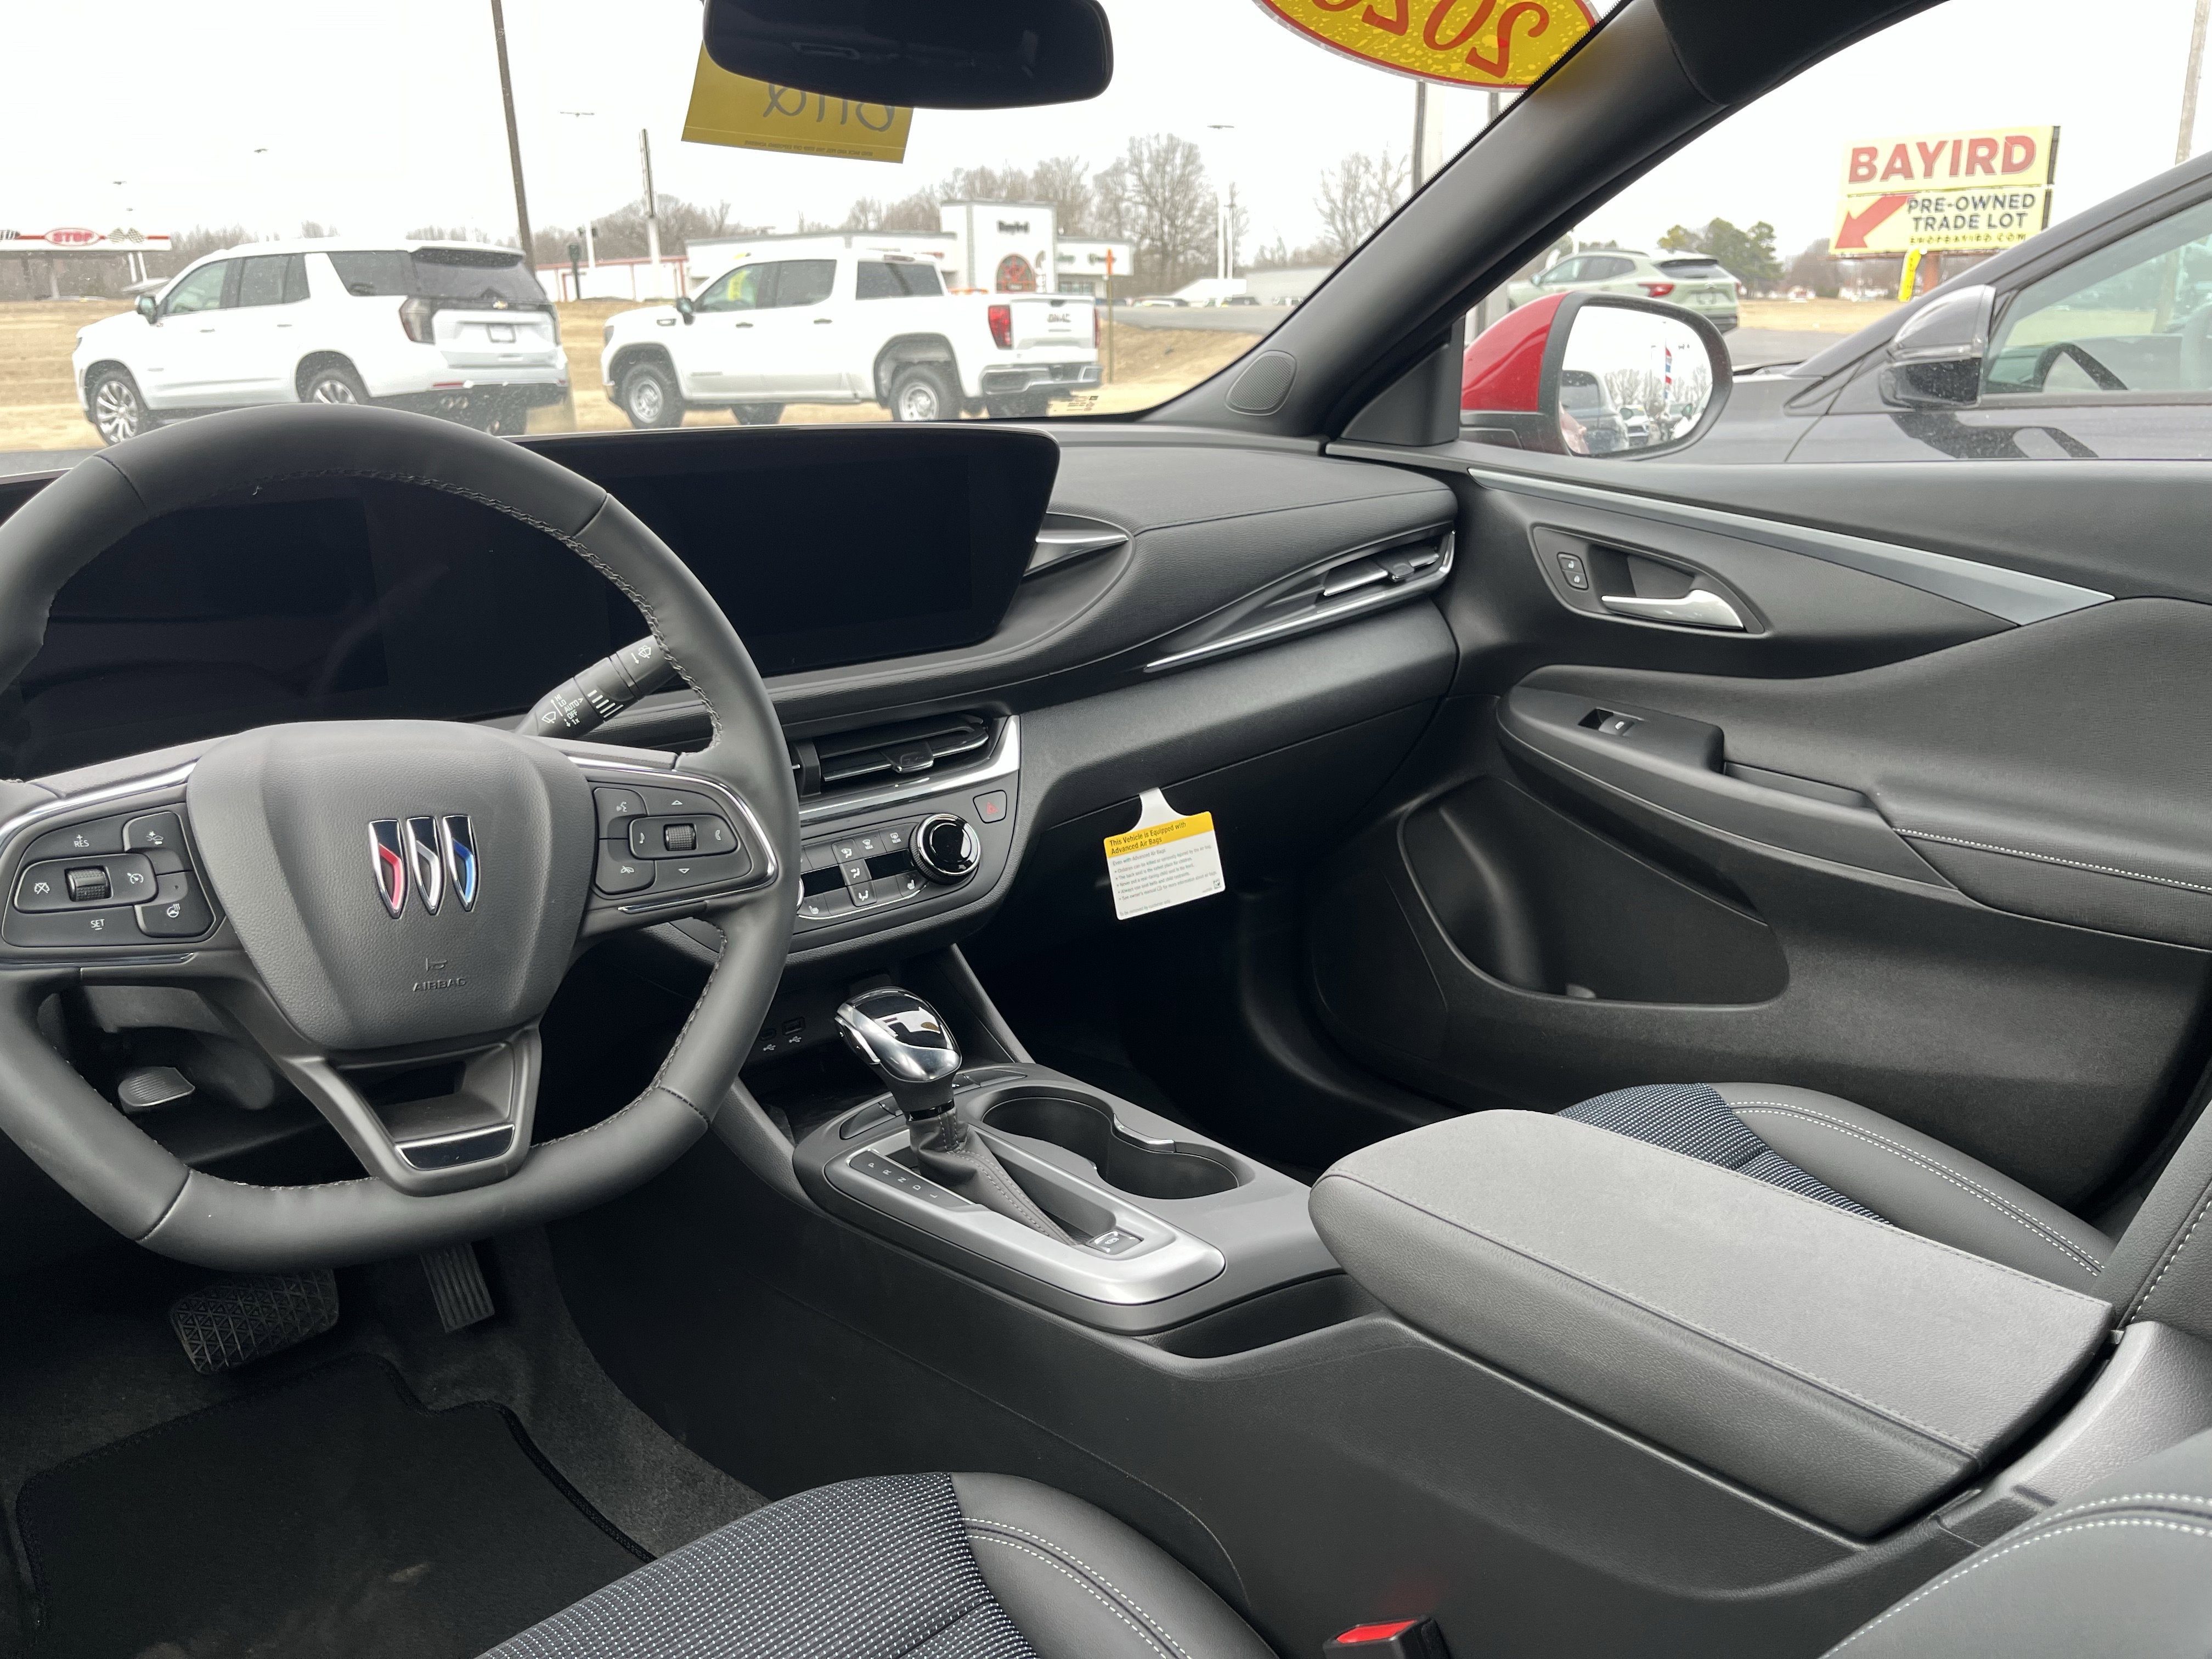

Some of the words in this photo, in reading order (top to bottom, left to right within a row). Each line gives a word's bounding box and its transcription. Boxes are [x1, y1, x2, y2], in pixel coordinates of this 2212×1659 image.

[1848, 135, 2036, 184] BAYIRD
[1908, 193, 2036, 214] PRE-OWNED
[1912, 213, 1980, 232] TRADE
[1988, 211, 2028, 229] LOT
[558, 699, 567, 707] LO
[567, 709, 578, 720] OFF
[1123, 833, 1143, 843] Vehicle
[1150, 825, 1174, 836] Equipped
[1111, 843, 1138, 855] Advanced
[90, 918, 105, 928] SET
[413, 978, 466, 991] AIRBAG
